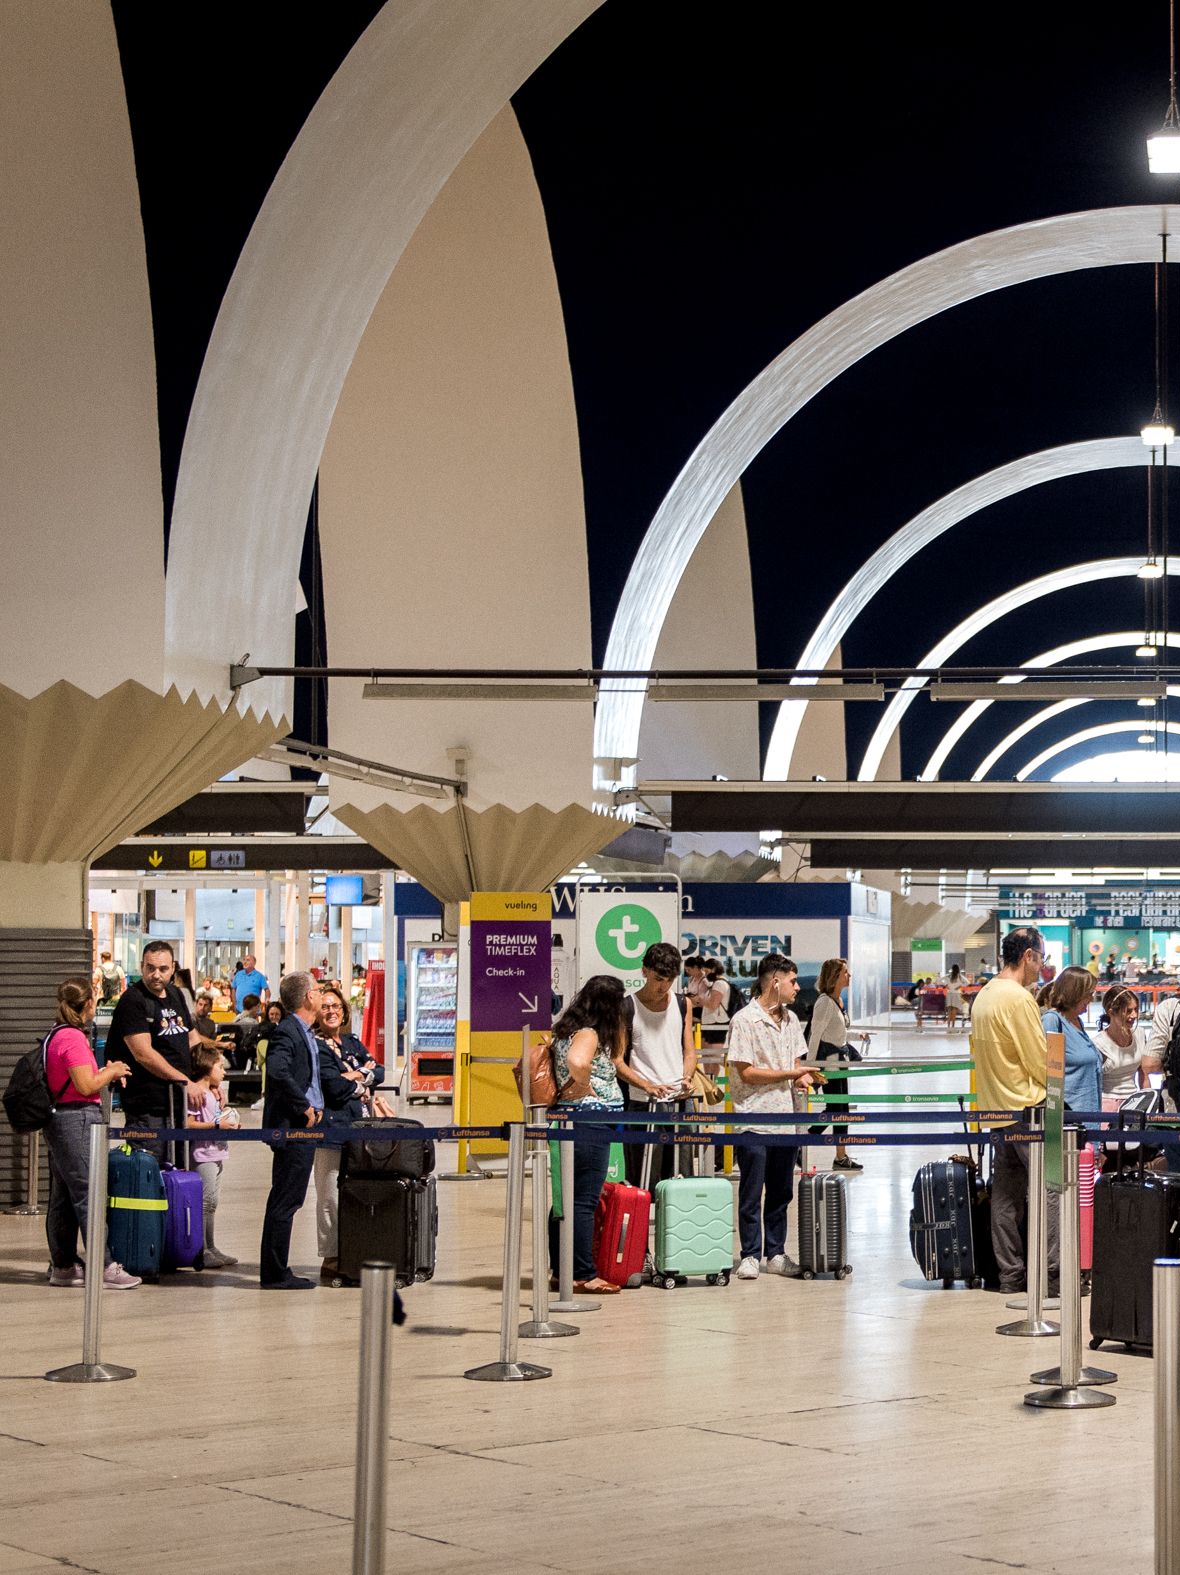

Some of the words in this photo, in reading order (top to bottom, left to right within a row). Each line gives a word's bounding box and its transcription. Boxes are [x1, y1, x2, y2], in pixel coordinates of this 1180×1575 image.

[504, 900, 538, 912] vueling
[486, 935, 538, 945] PREMIUM
[486, 946, 537, 956] TIMEFLEX
[486, 967, 525, 977] Check-in
[682, 1114, 717, 1122] Lufthansa
[831, 1114, 865, 1122] Lufthansa
[119, 1130, 157, 1139] Lufthansa
[286, 1131, 324, 1139] Lufthansa
[452, 1129, 490, 1137] Lufthansa
[674, 1134, 712, 1143] Lufthansa
[838, 1136, 877, 1144] Lufthansa
[1004, 1134, 1042, 1142] Lufthansa
